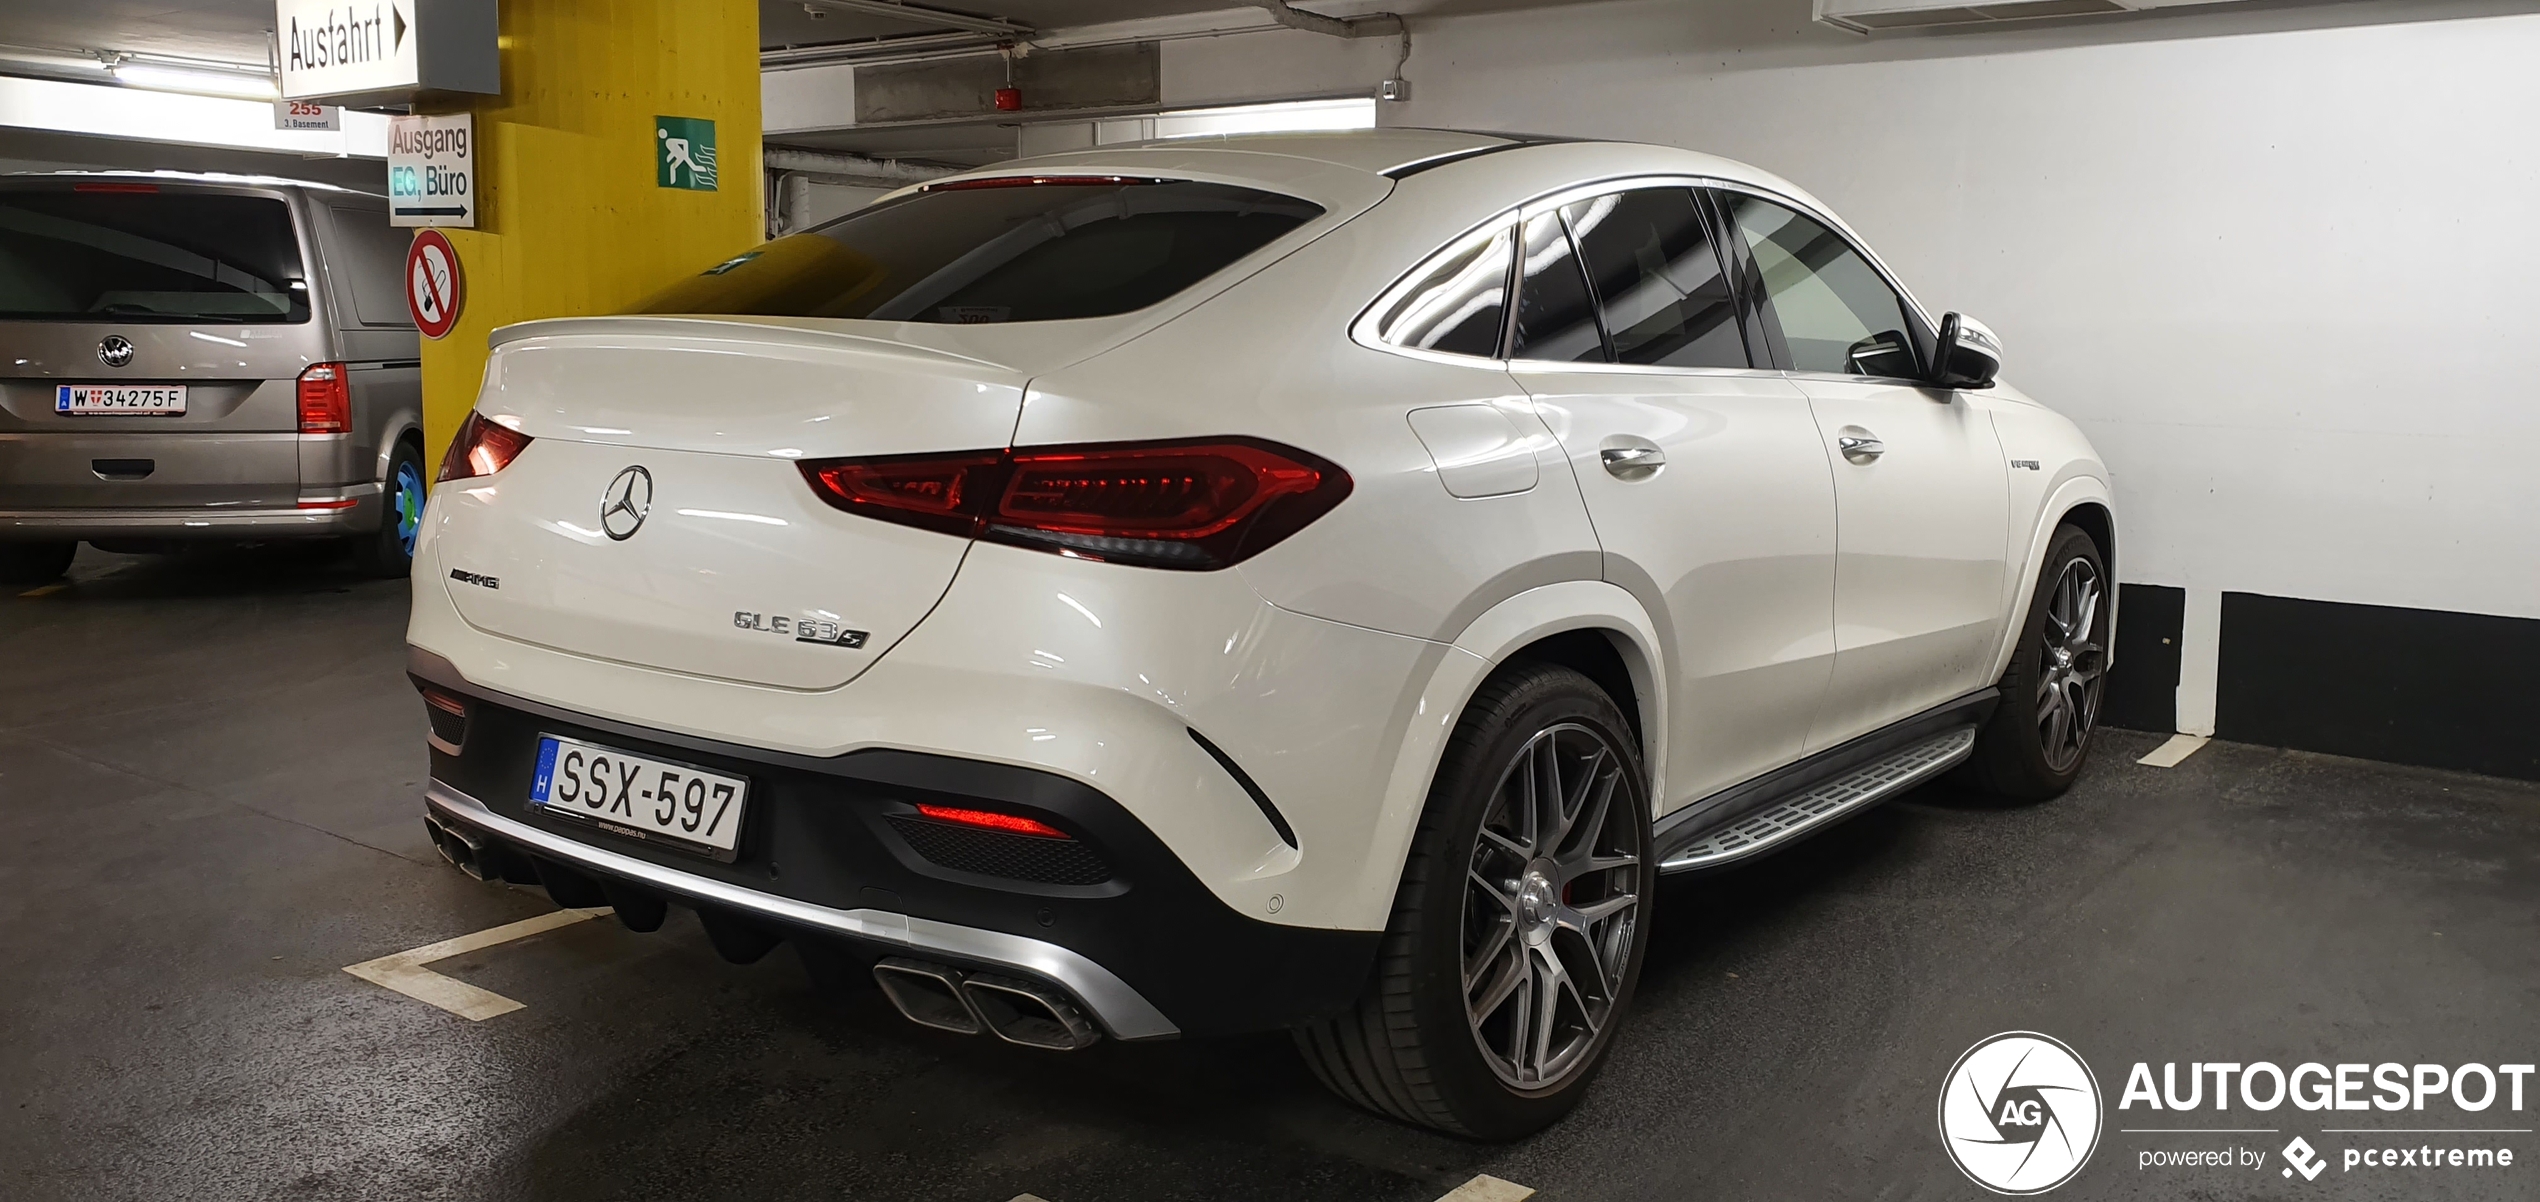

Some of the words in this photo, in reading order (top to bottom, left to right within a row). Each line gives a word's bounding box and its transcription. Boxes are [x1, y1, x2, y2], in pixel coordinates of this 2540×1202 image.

[290, 3, 382, 72] Ausfahrt
[290, 101, 322, 116] 255
[284, 118, 292, 128] 3.
[293, 119, 329, 129] Basement
[392, 124, 467, 160] Ausgang
[393, 166, 421, 202] EG,
[426, 165, 467, 196] Büro
[74, 390, 88, 407] W
[465, 571, 500, 590] AMG
[734, 611, 791, 634] GLE
[536, 774, 548, 793] H
[558, 750, 736, 837] SSX-597
